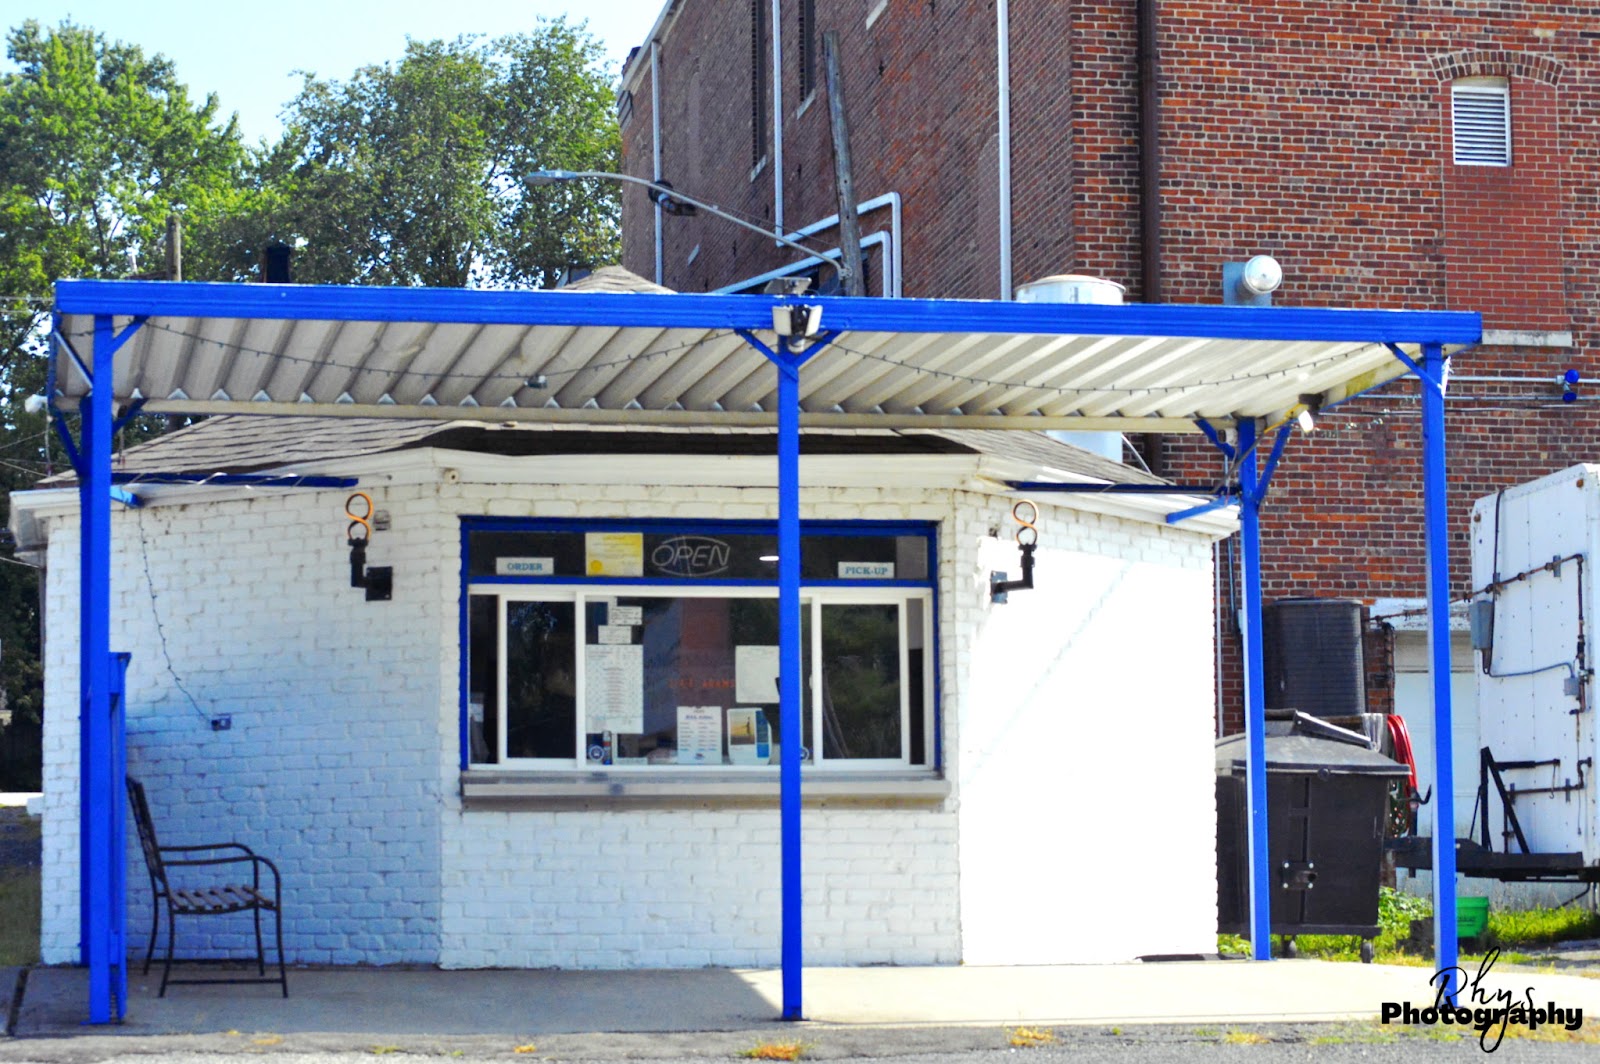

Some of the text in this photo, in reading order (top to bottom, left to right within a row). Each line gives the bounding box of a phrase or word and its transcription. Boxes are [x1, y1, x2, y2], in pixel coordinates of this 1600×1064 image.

[652, 545, 731, 566] OPEN
[507, 562, 543, 571] ORDER
[845, 566, 888, 575] PICK-UP
